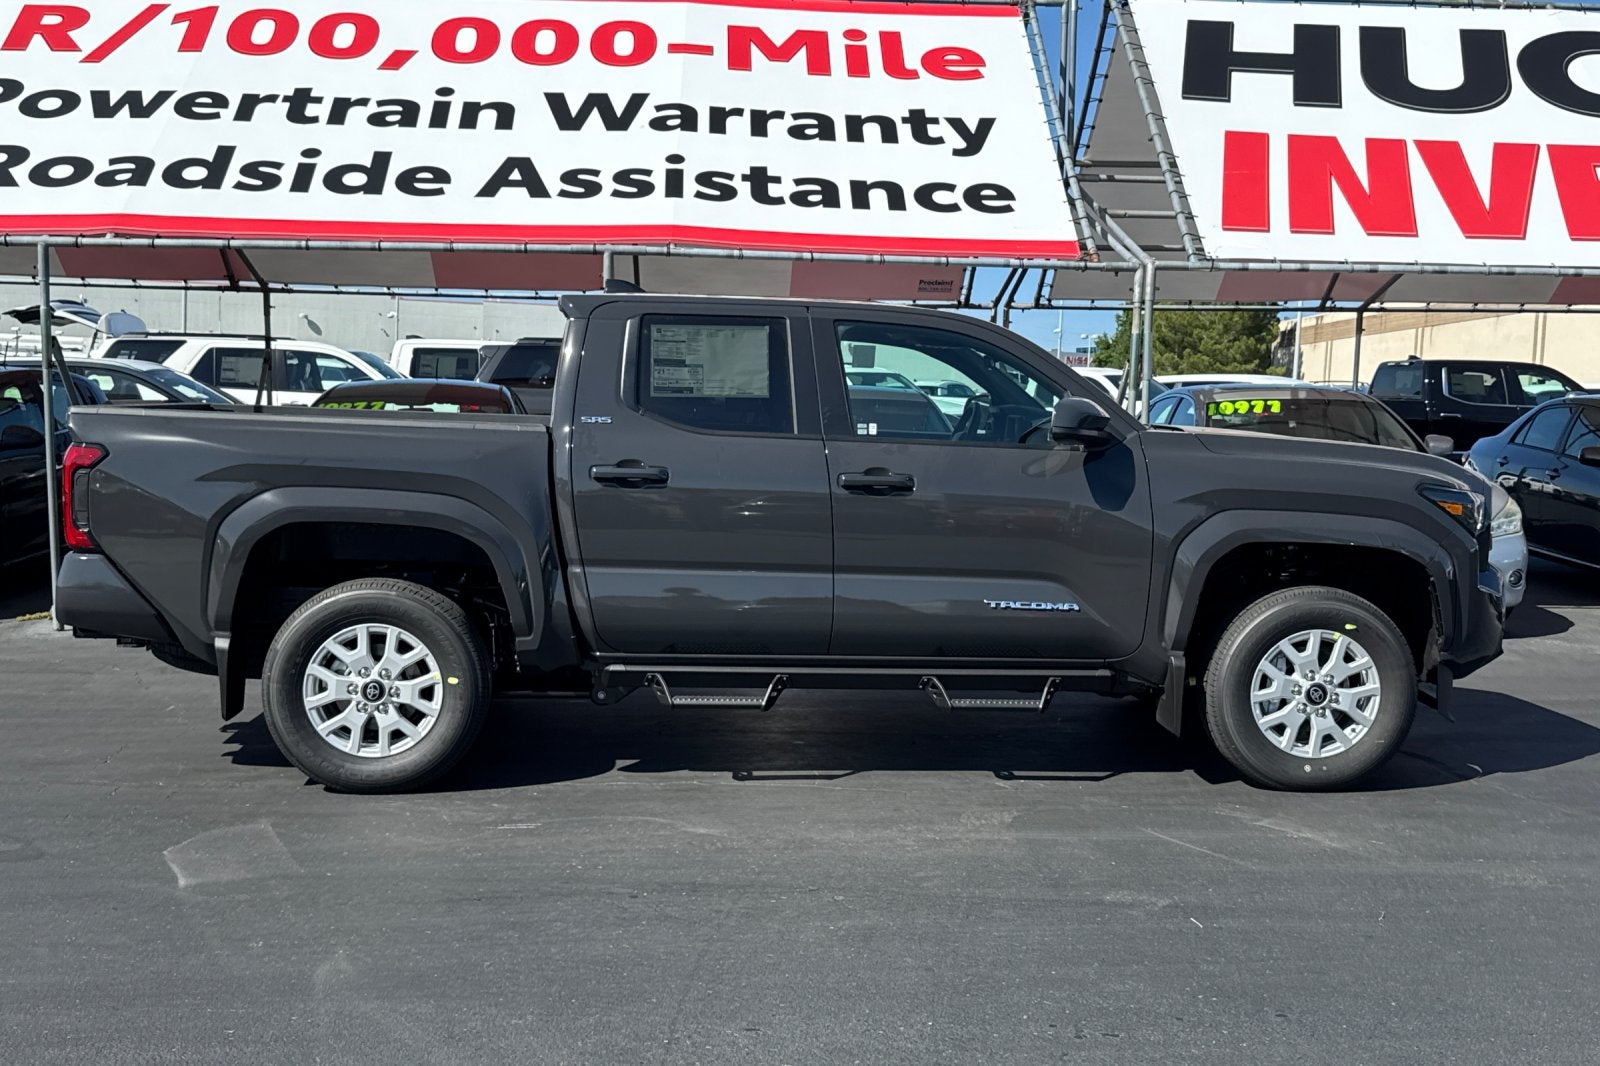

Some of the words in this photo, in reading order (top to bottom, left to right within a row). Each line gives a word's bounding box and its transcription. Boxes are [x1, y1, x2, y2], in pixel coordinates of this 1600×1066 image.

[544, 93, 995, 156] Warranty
[476, 154, 1015, 213] Assistance
[1208, 400, 1281, 416] 10977
[983, 599, 1079, 610] TACOMA
